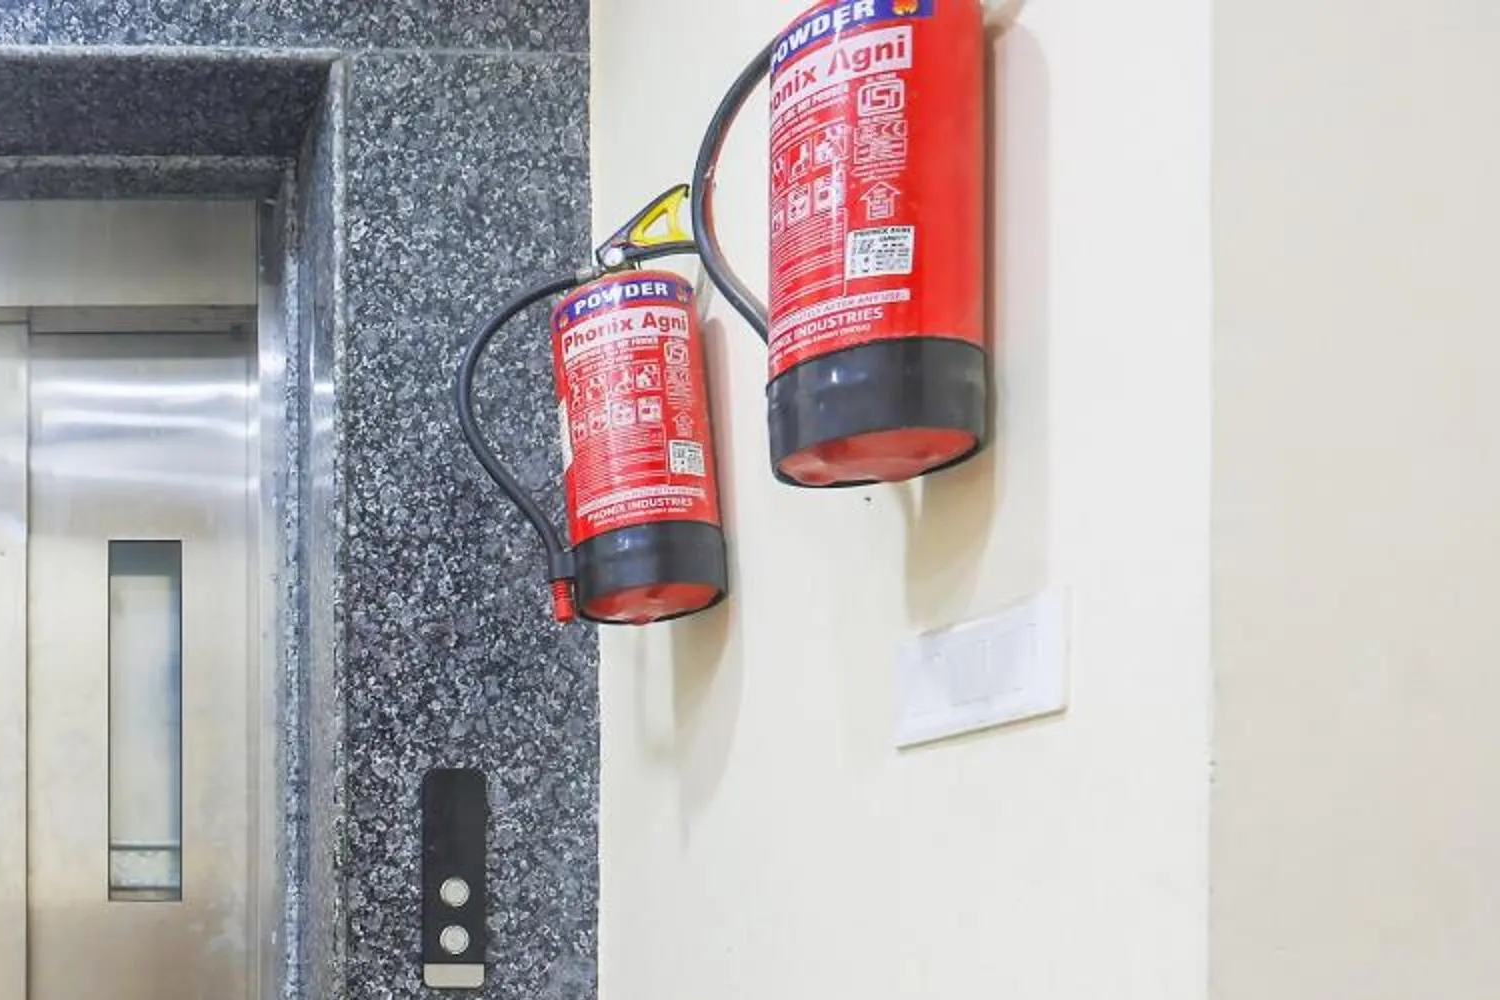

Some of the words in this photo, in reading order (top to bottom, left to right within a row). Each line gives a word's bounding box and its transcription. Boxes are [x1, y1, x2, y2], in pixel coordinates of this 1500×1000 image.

[828, 34, 905, 77] Agni
[574, 281, 669, 316] POWDER
[642, 311, 688, 333] Agni
[794, 306, 885, 336] INDUSTRIES
